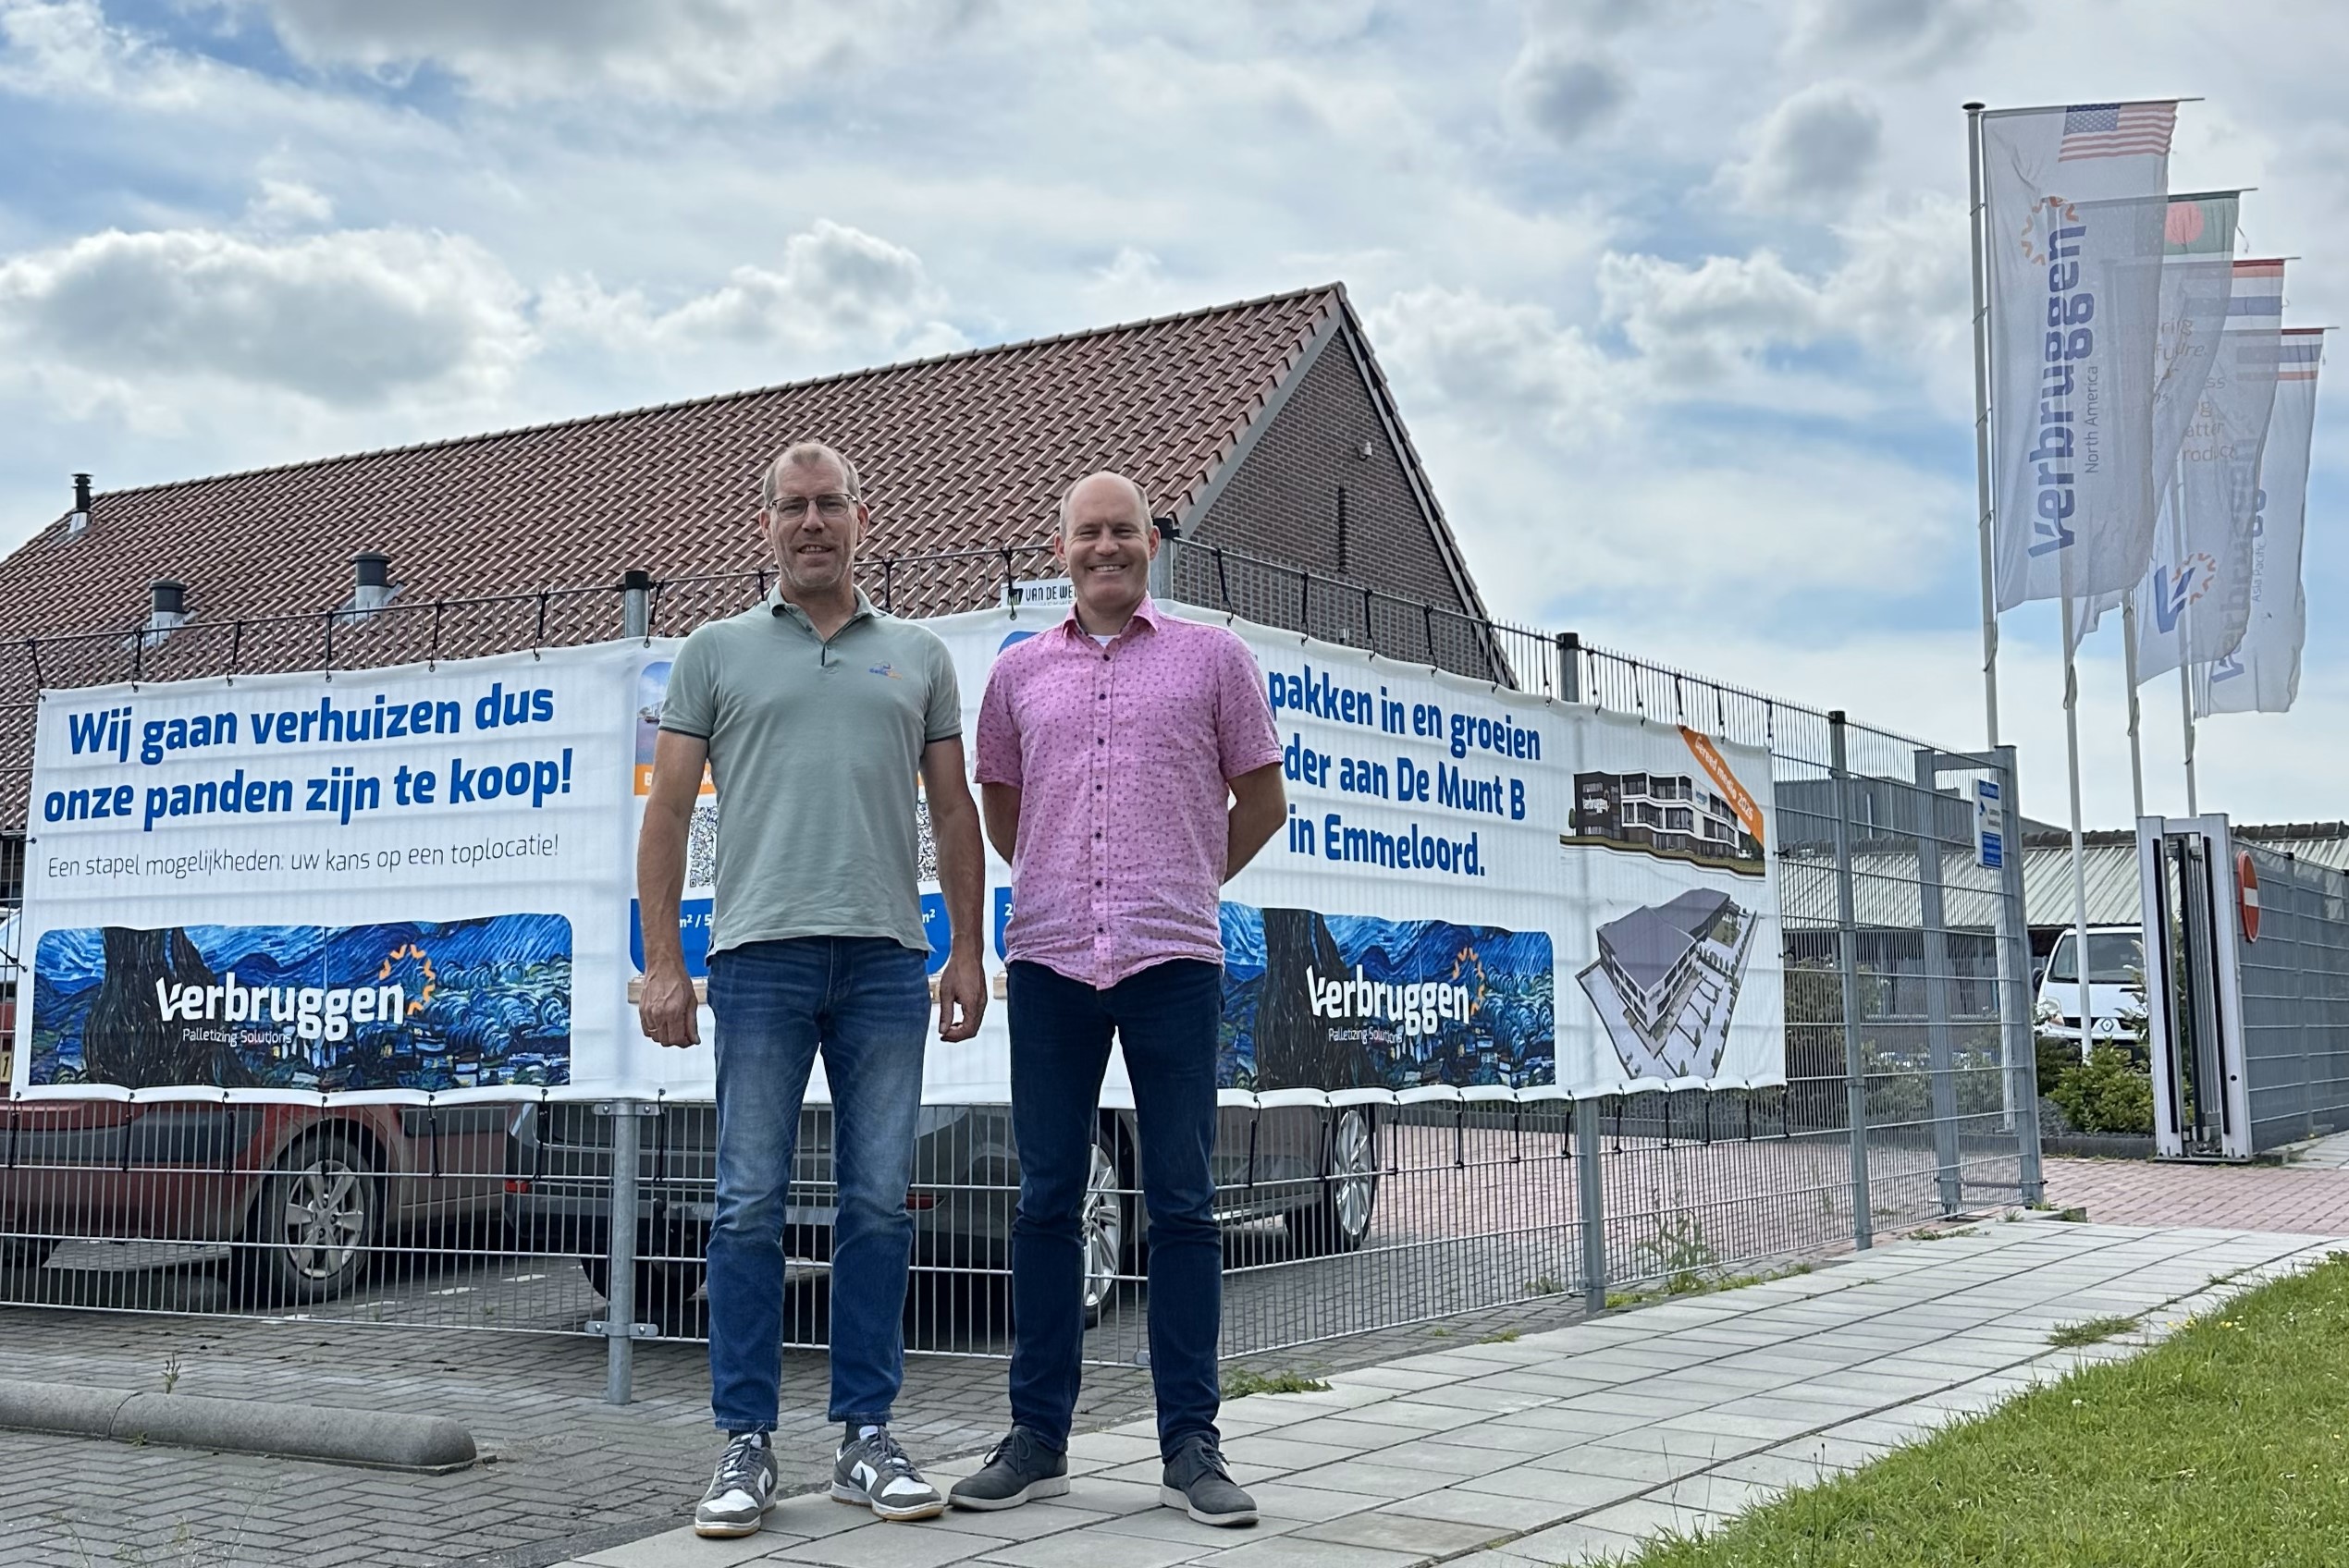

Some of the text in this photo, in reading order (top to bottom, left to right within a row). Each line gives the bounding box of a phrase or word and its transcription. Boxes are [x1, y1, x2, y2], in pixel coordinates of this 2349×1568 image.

[2028, 226, 2094, 557] Verbruggen
[2085, 366, 2098, 473] North America
[1026, 587, 1043, 601] VAN
[1047, 586, 1057, 600] DE
[69, 682, 553, 766] Wij gaan verhuizen dus
[1269, 667, 1541, 761] pakken in en groeien
[44, 747, 572, 832] onze panden zijn te koop!
[1340, 757, 1388, 800] aan
[1396, 758, 1430, 802] De
[1438, 763, 1504, 817] Munt
[1510, 778, 1526, 821] B
[1737, 792, 1753, 821] 2025
[49, 833, 559, 879] Een stapel mogelijkheden: uw kans op een toplocatie!
[1289, 803, 1486, 876] in Emmeloord.
[155, 972, 405, 1041] Verbruggen
[1306, 964, 1470, 1036] Verbruggen
[1329, 1025, 1402, 1045] Palletizing Solutions
[183, 1028, 292, 1047] Palletizing Solutions
